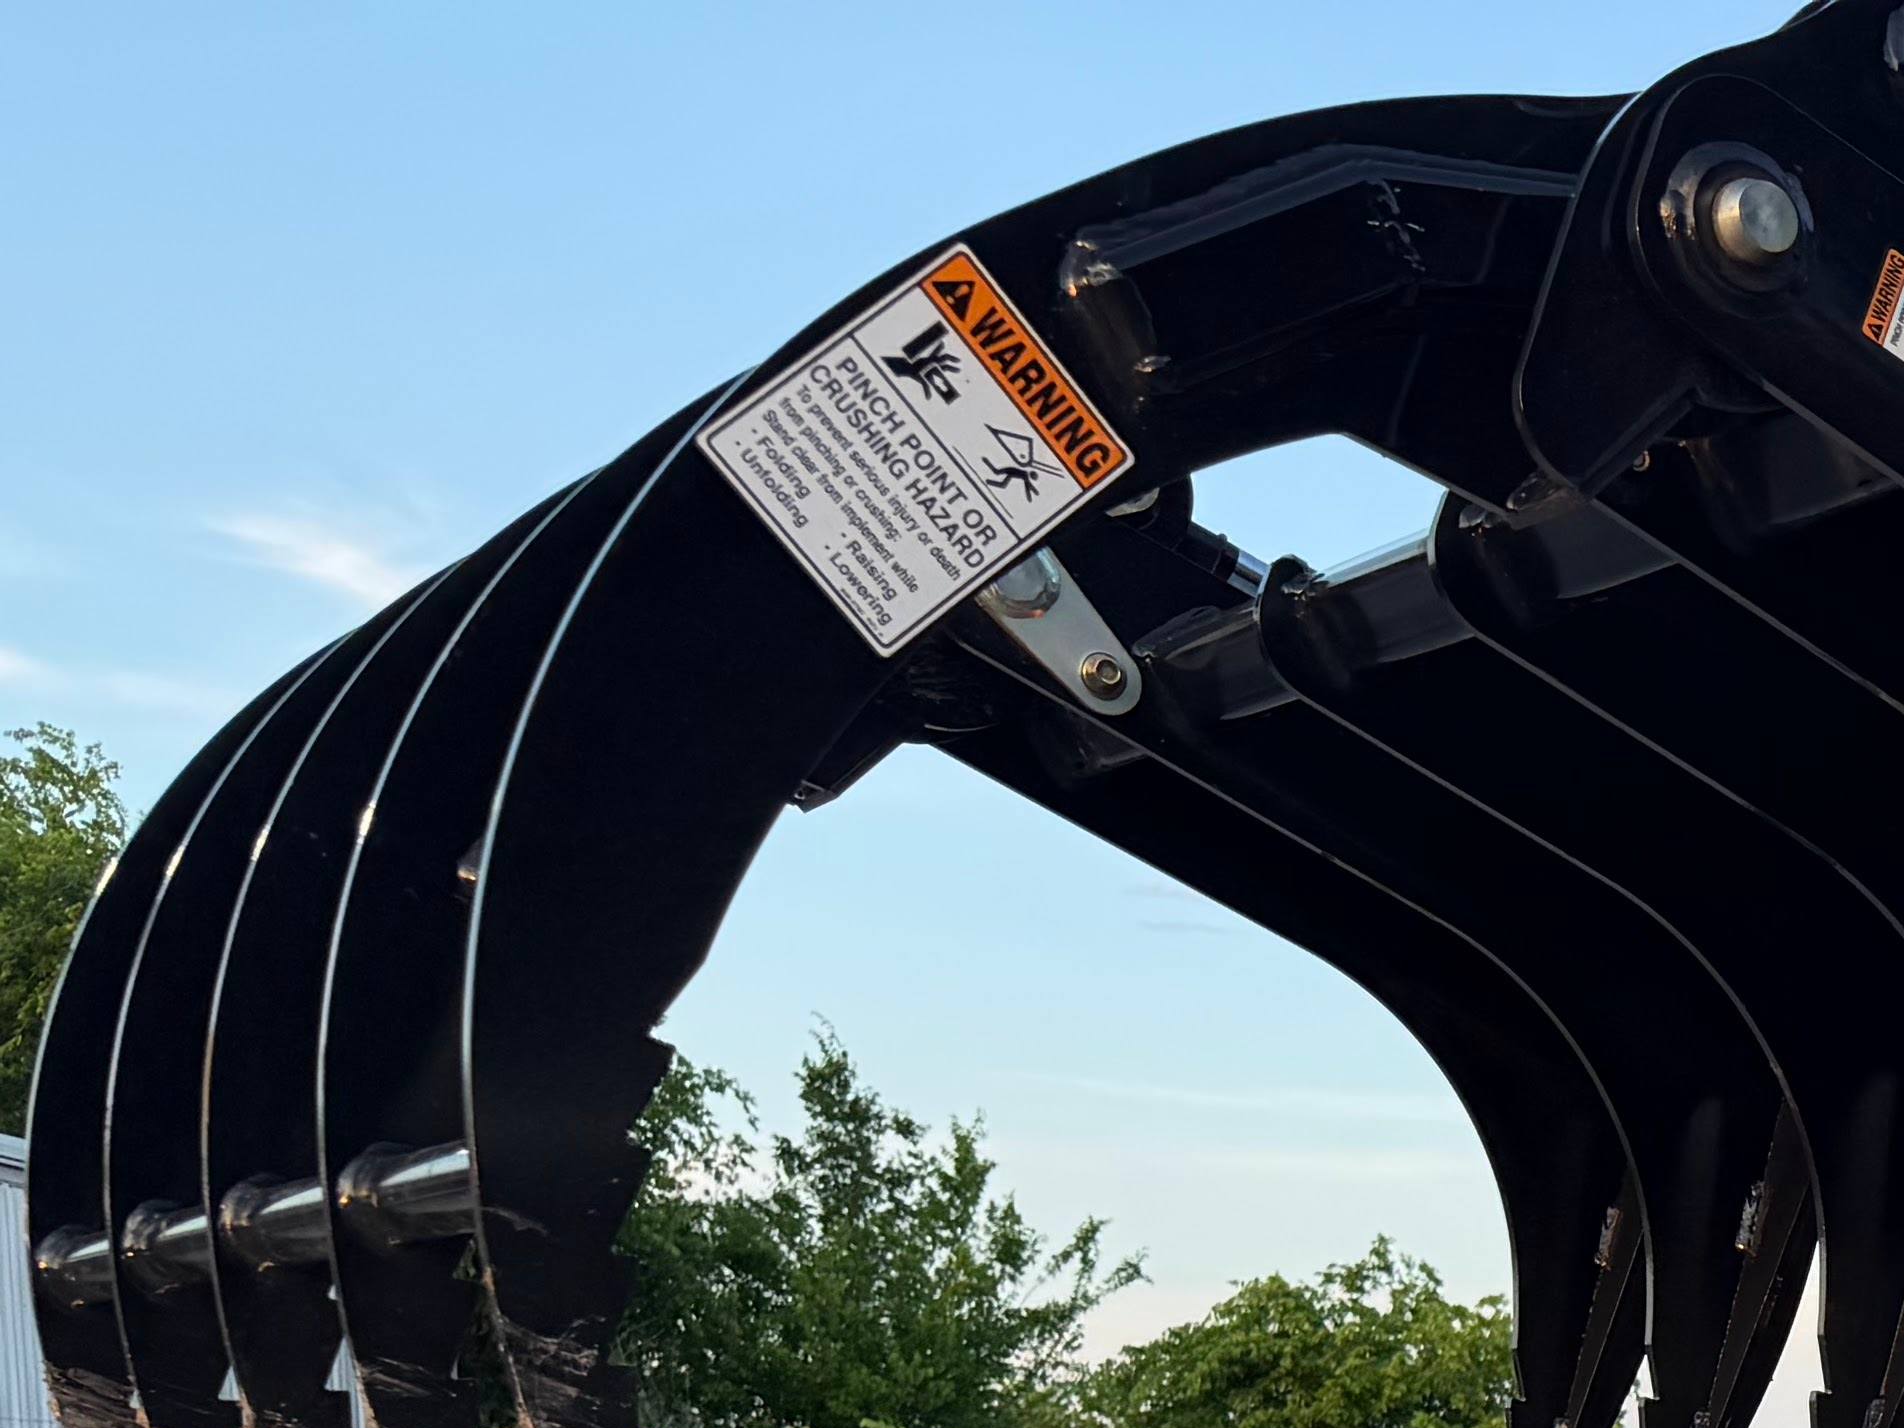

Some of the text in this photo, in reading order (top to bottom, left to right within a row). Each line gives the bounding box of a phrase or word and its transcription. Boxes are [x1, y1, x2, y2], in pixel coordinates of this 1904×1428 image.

[753, 435, 813, 501] Folding
[778, 396, 807, 426] from
[798, 423, 848, 477] pinching
[841, 473, 858, 490] or
[851, 486, 904, 544] crushing:
[808, 362, 911, 480] CRUSHING
[904, 478, 986, 570] HAZARD
[835, 355, 998, 547] PINCH POINT OR
[969, 308, 1112, 478] WARNING
[737, 448, 811, 529] Unfolding
[761, 409, 796, 447] Stand
[790, 444, 820, 476] clear
[815, 473, 844, 504] from
[836, 501, 894, 565] implement
[889, 560, 920, 594] while
[794, 384, 963, 581] To prevent serious injury or death
[826, 552, 894, 627] Lowering
[843, 539, 899, 602] Raising
